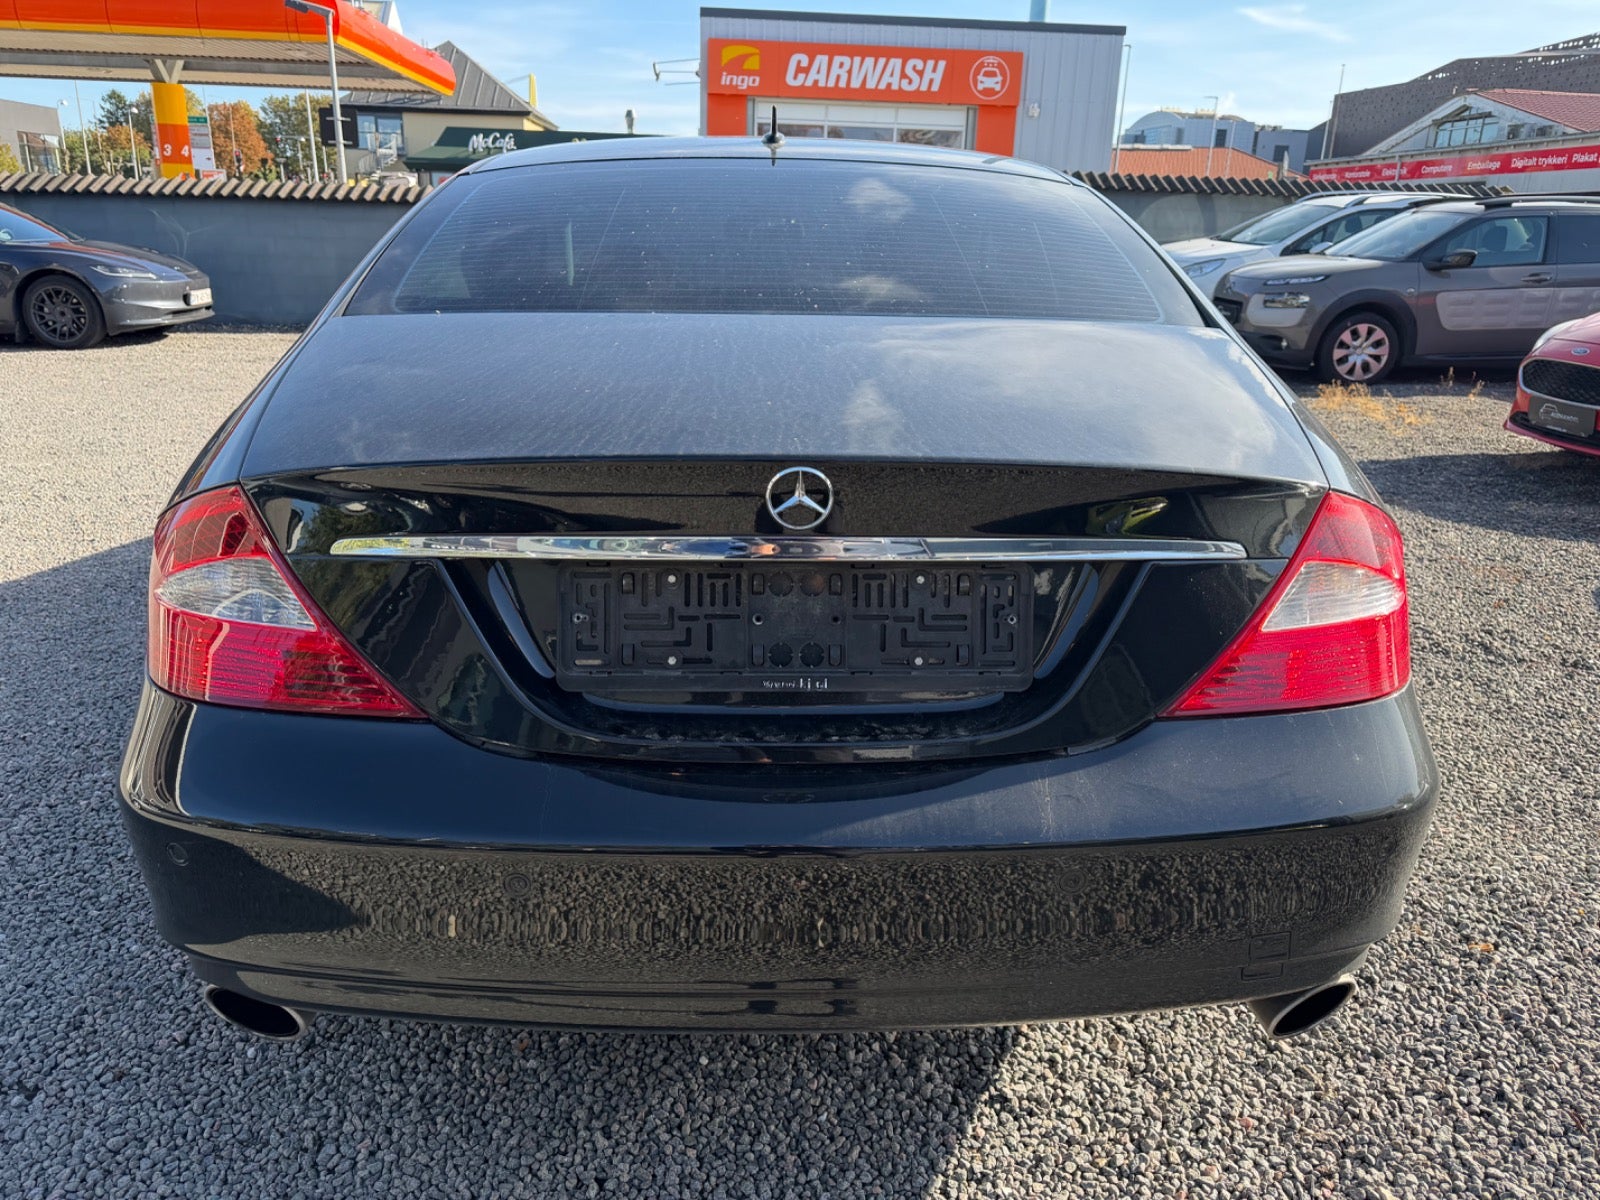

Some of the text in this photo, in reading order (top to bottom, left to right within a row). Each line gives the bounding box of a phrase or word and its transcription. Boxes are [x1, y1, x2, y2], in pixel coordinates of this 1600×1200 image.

[785, 53, 946, 92] CARWASH
[720, 71, 760, 89] ingo
[163, 144, 172, 157] 3
[181, 145, 190, 157] 4
[1511, 154, 1568, 168] Digitalt trykkeri
[1572, 153, 1598, 163] Plakat
[1382, 166, 1408, 177] Elektnik
[1467, 160, 1501, 171] Emballage
